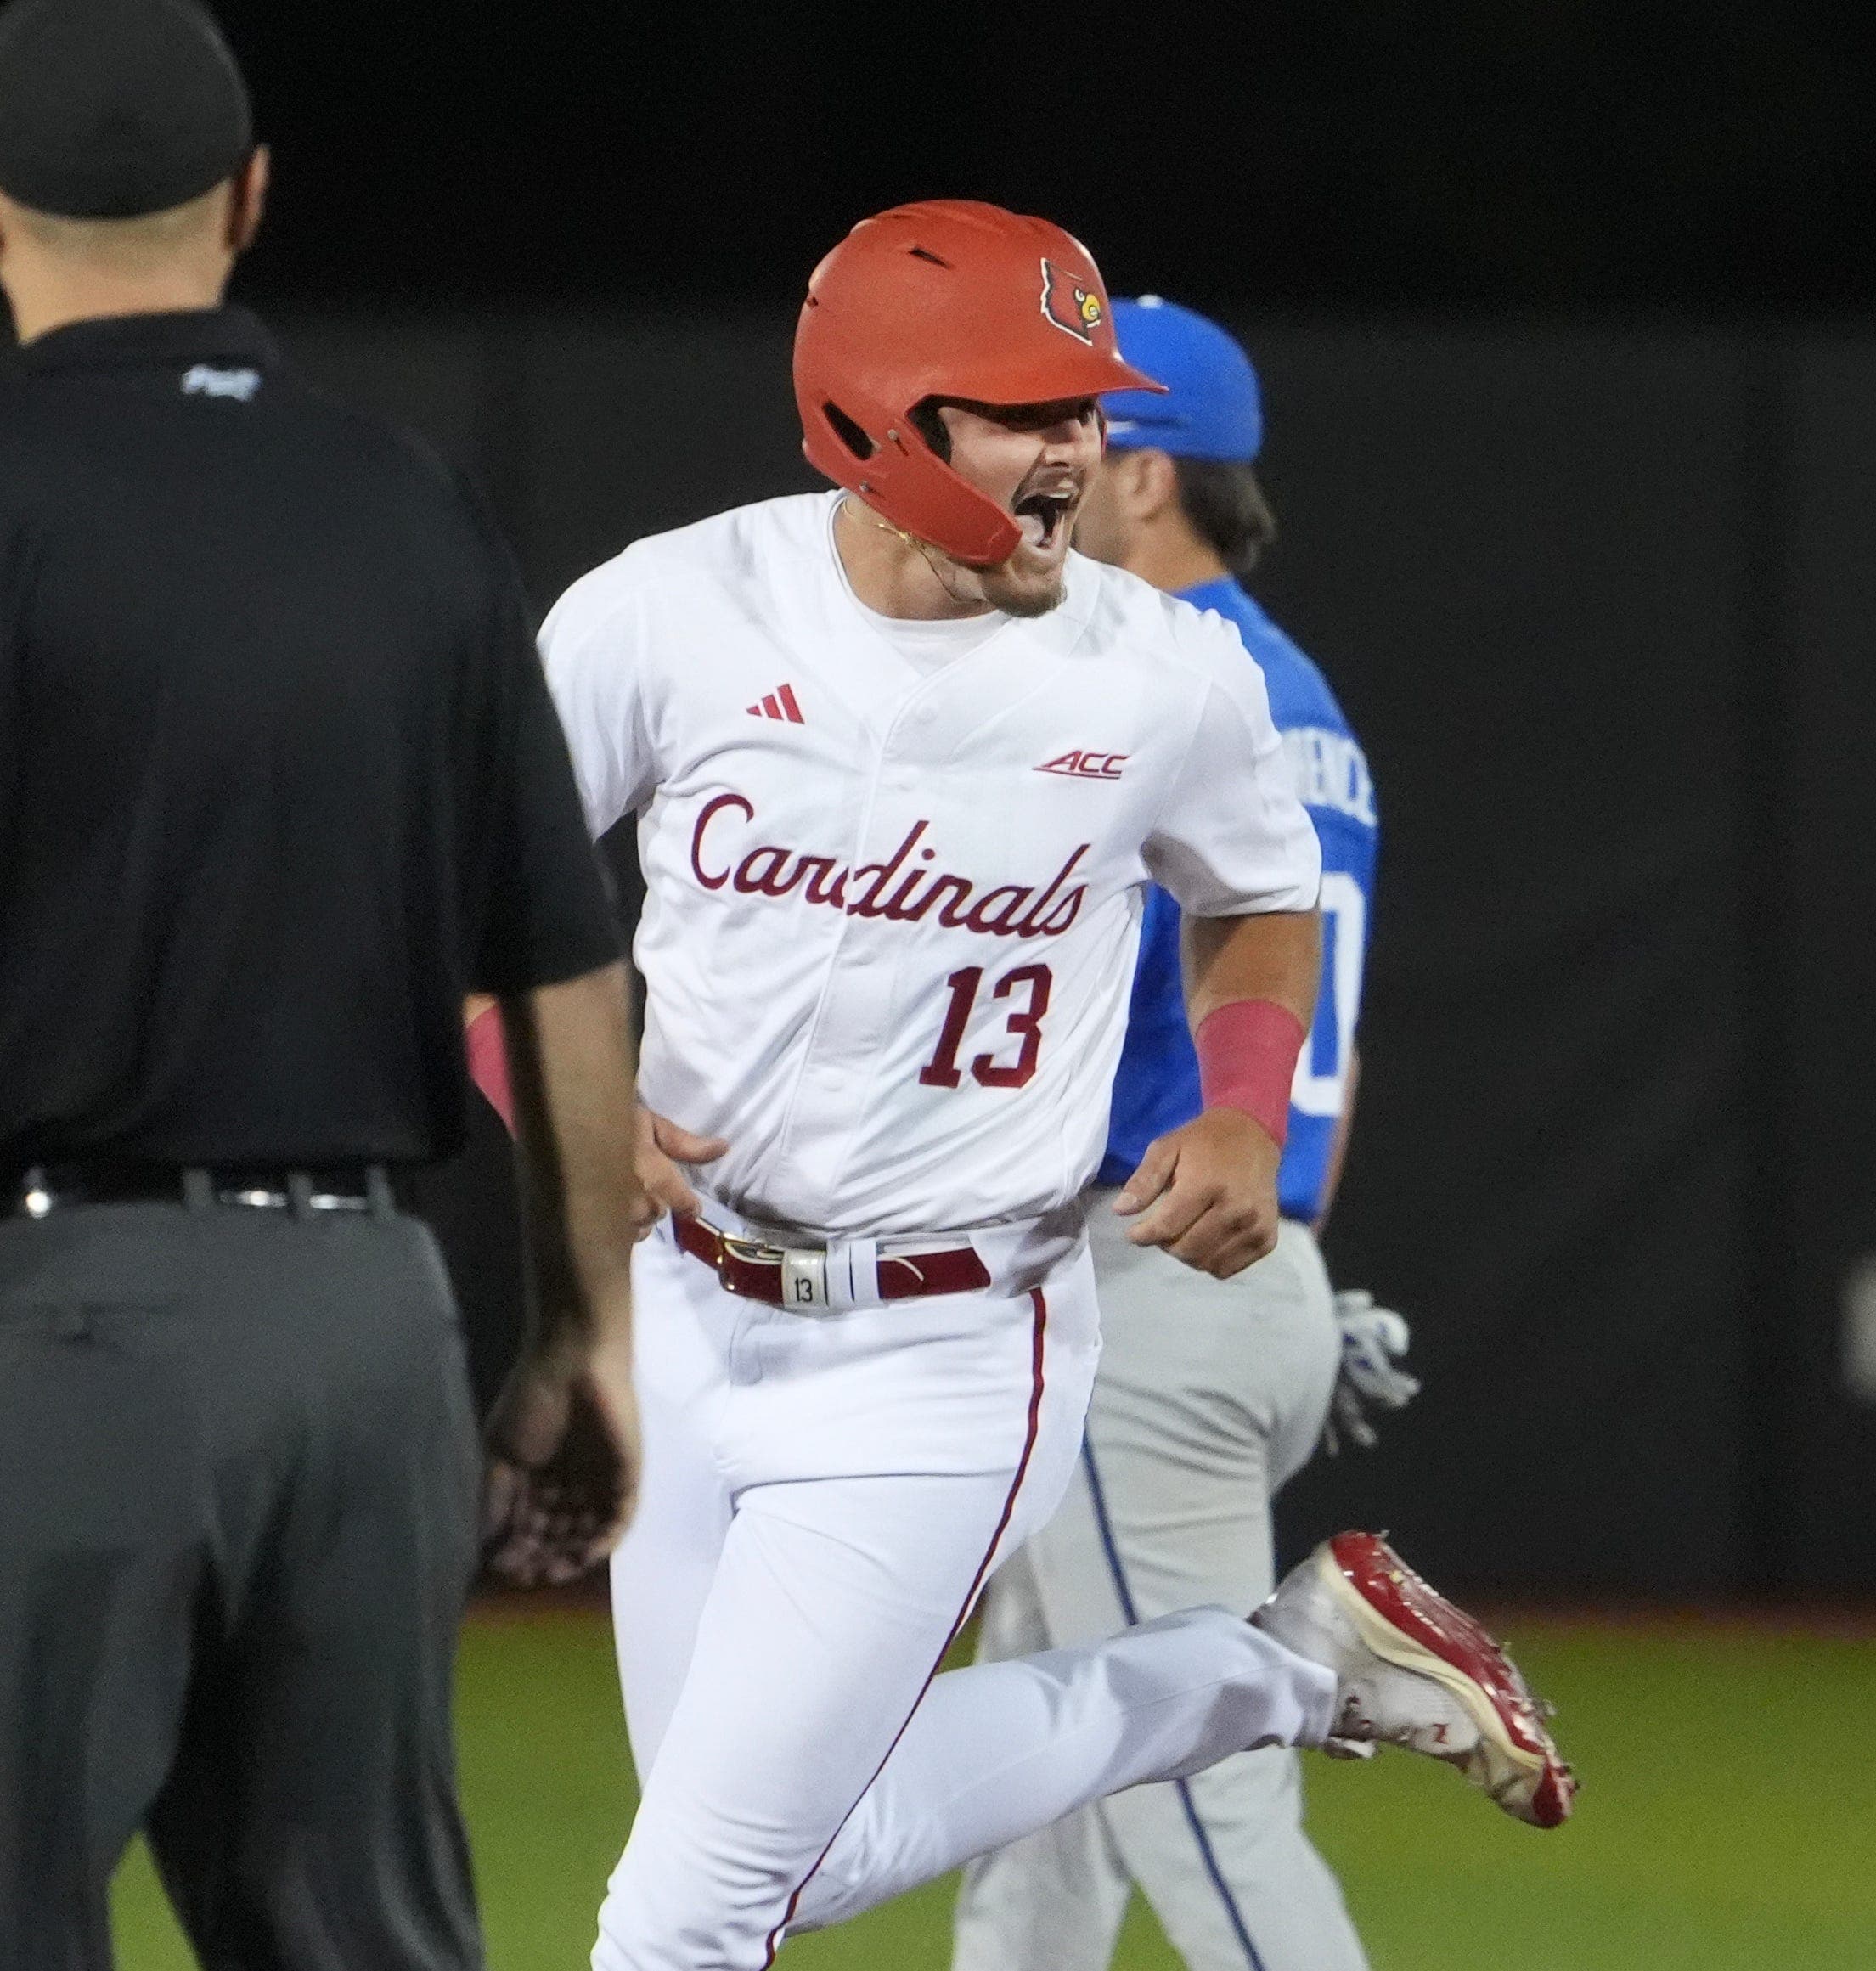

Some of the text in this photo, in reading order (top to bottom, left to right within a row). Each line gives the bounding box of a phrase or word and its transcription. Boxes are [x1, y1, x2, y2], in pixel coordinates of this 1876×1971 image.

[1033, 750, 1130, 779] ACC
[690, 793, 1091, 938] Cardinals
[919, 963, 1053, 1090] 13
[795, 1277, 813, 1302] 13
